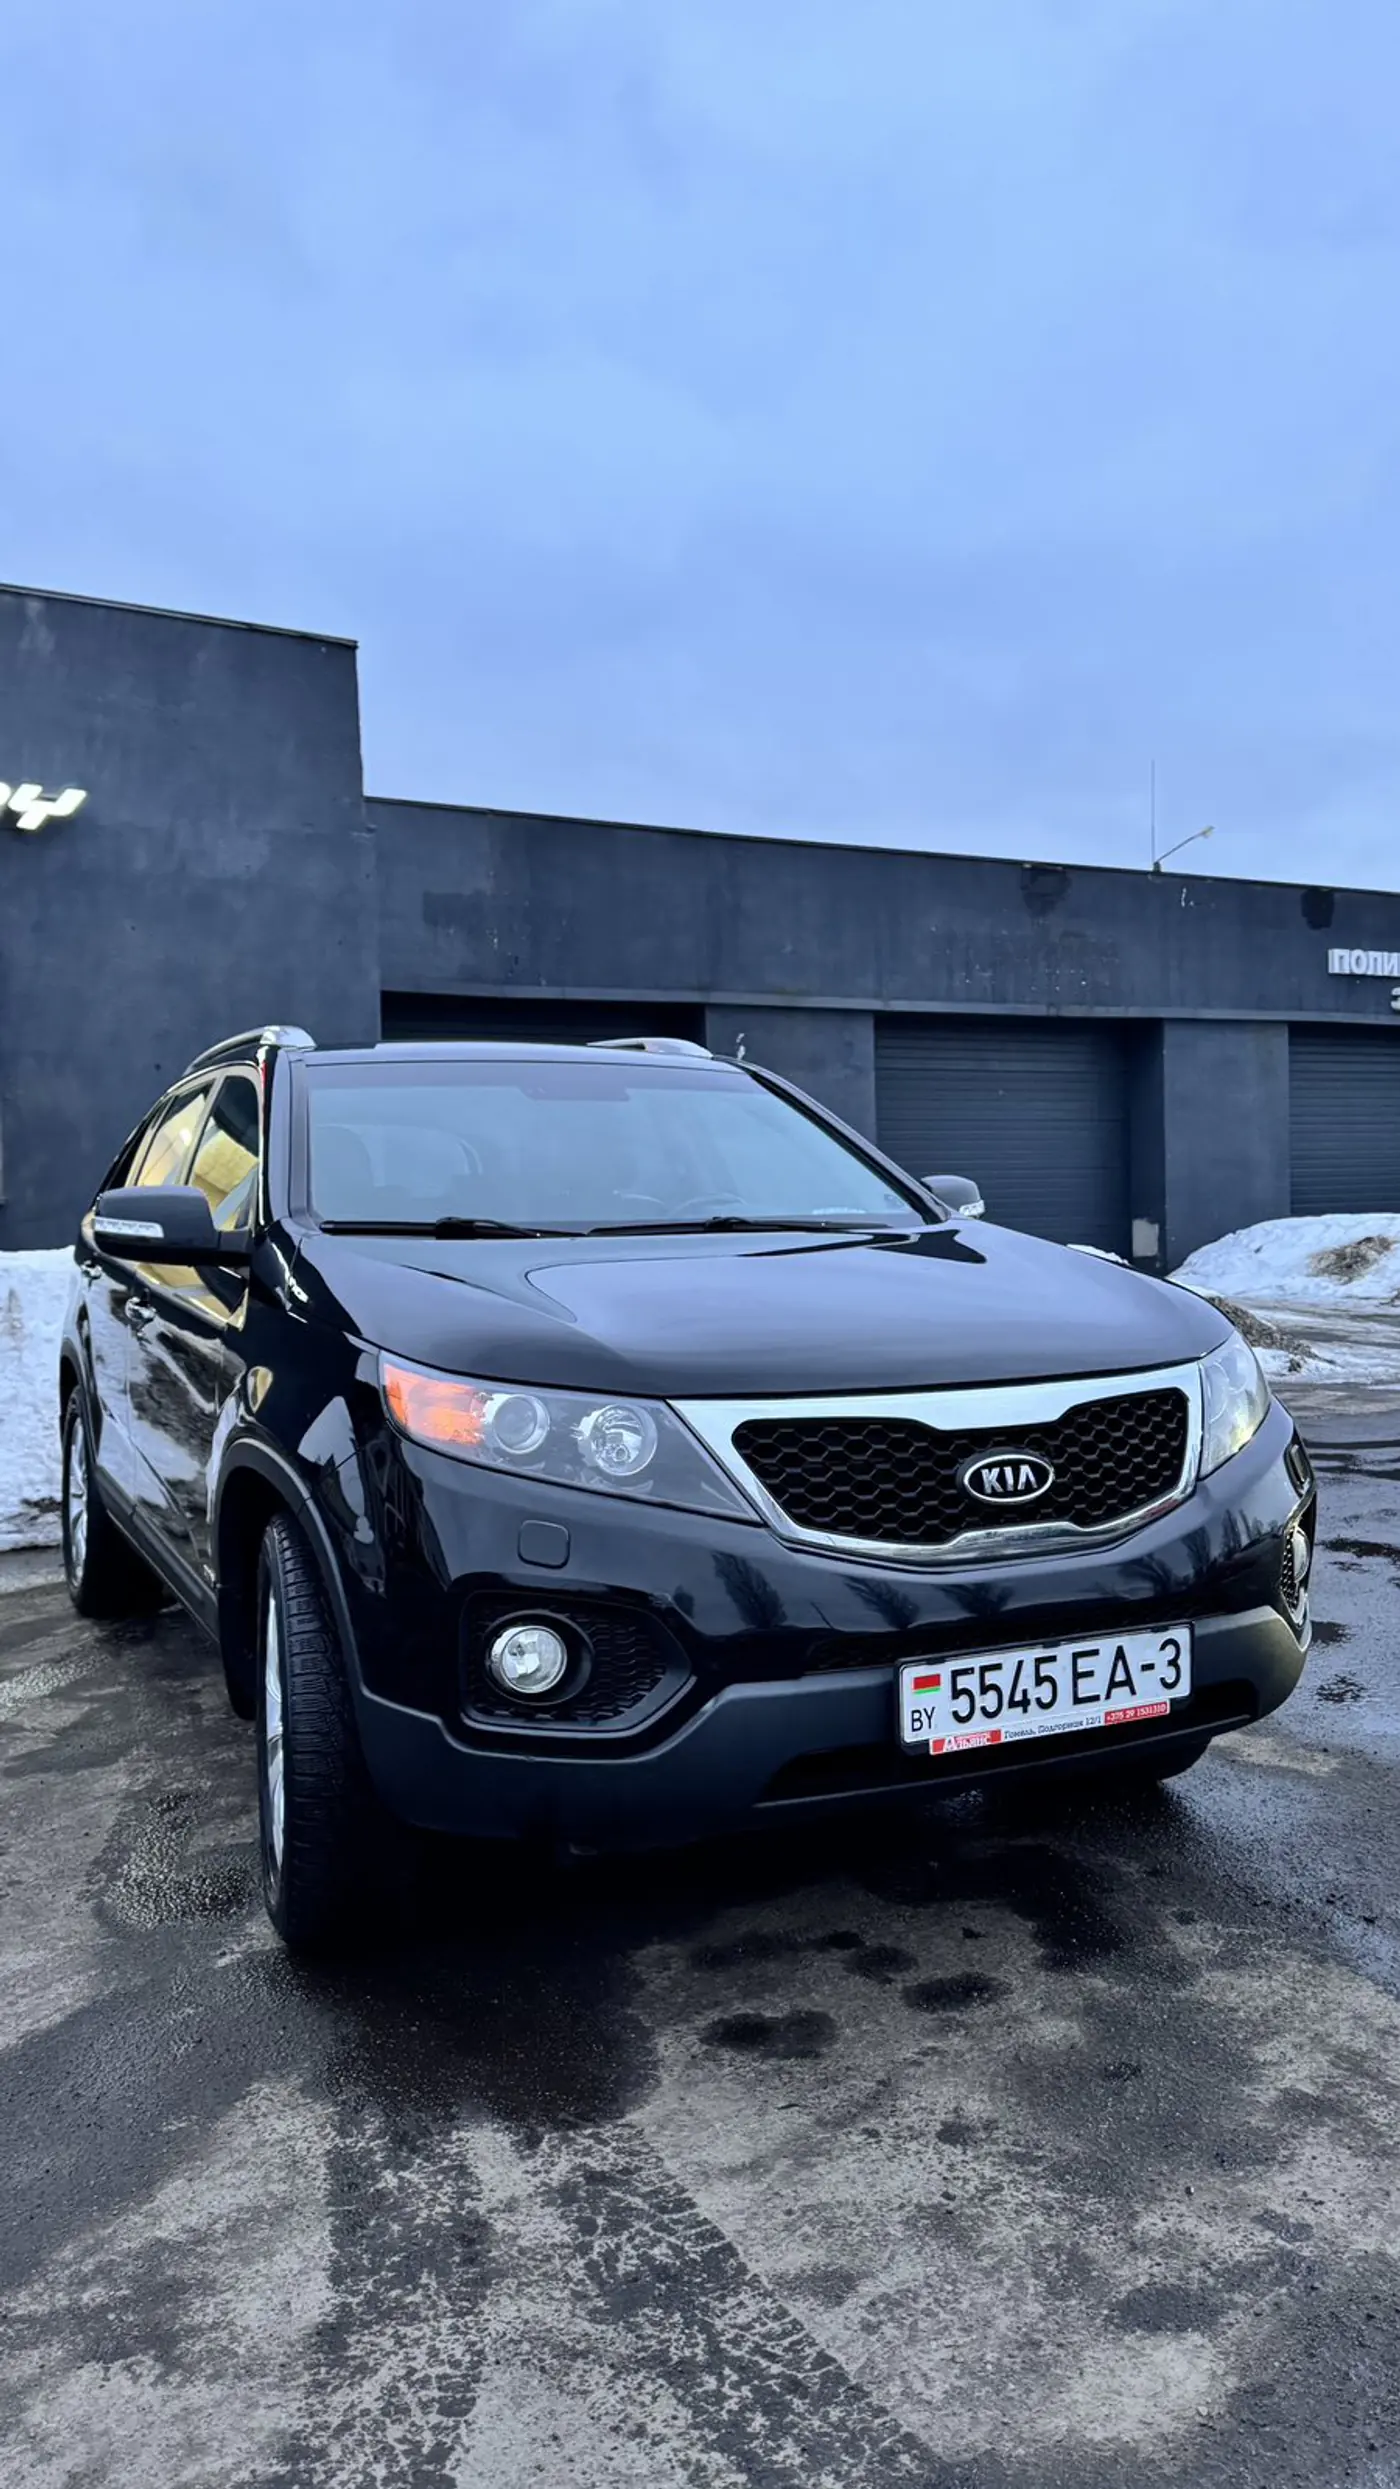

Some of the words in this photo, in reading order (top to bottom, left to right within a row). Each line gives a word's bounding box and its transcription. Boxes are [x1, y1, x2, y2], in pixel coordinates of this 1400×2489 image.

[981, 1464, 1038, 1494] KIA
[951, 1655, 1057, 1723] 5545
[1072, 1638, 1181, 1705] EA-3
[911, 1707, 935, 1732] BY
